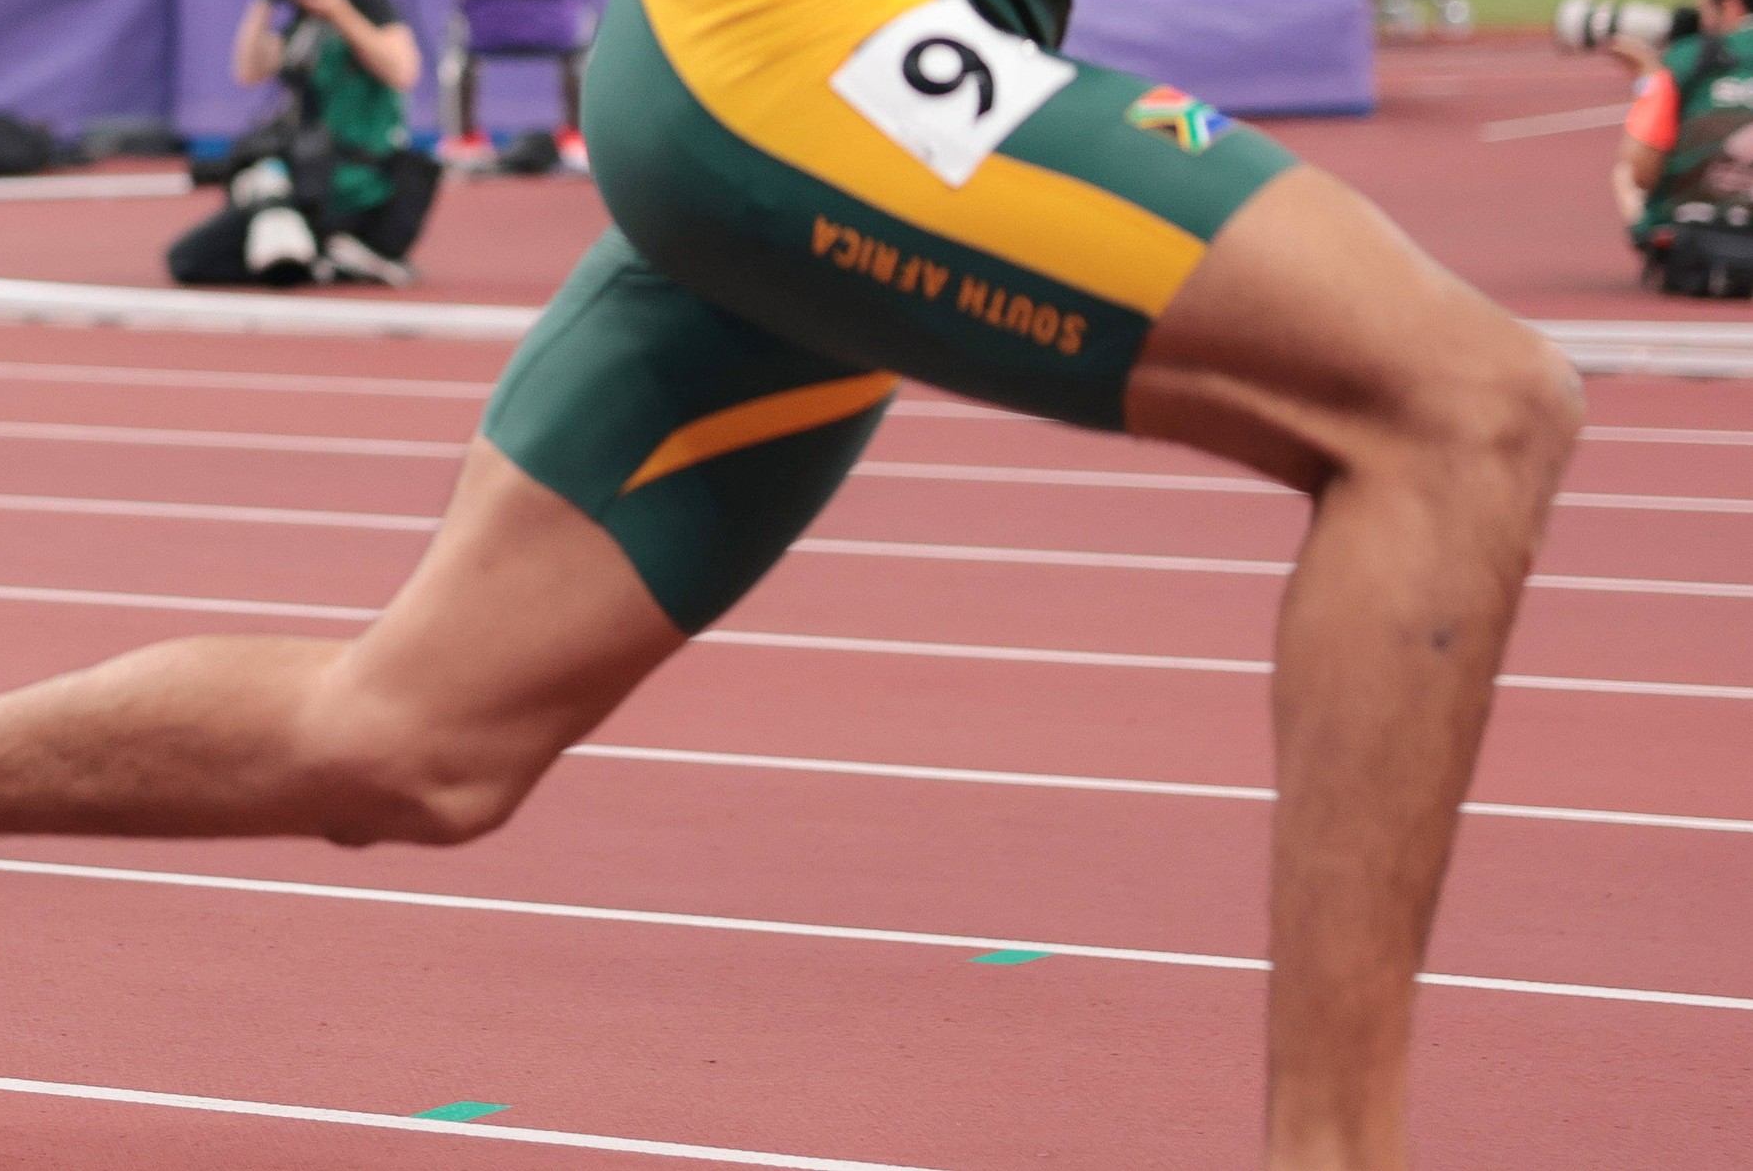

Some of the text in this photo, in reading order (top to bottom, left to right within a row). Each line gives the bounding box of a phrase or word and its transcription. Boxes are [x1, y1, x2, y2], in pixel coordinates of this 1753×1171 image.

[901, 37, 995, 125] 9
[810, 213, 1089, 355] SOUTH AFRICA
